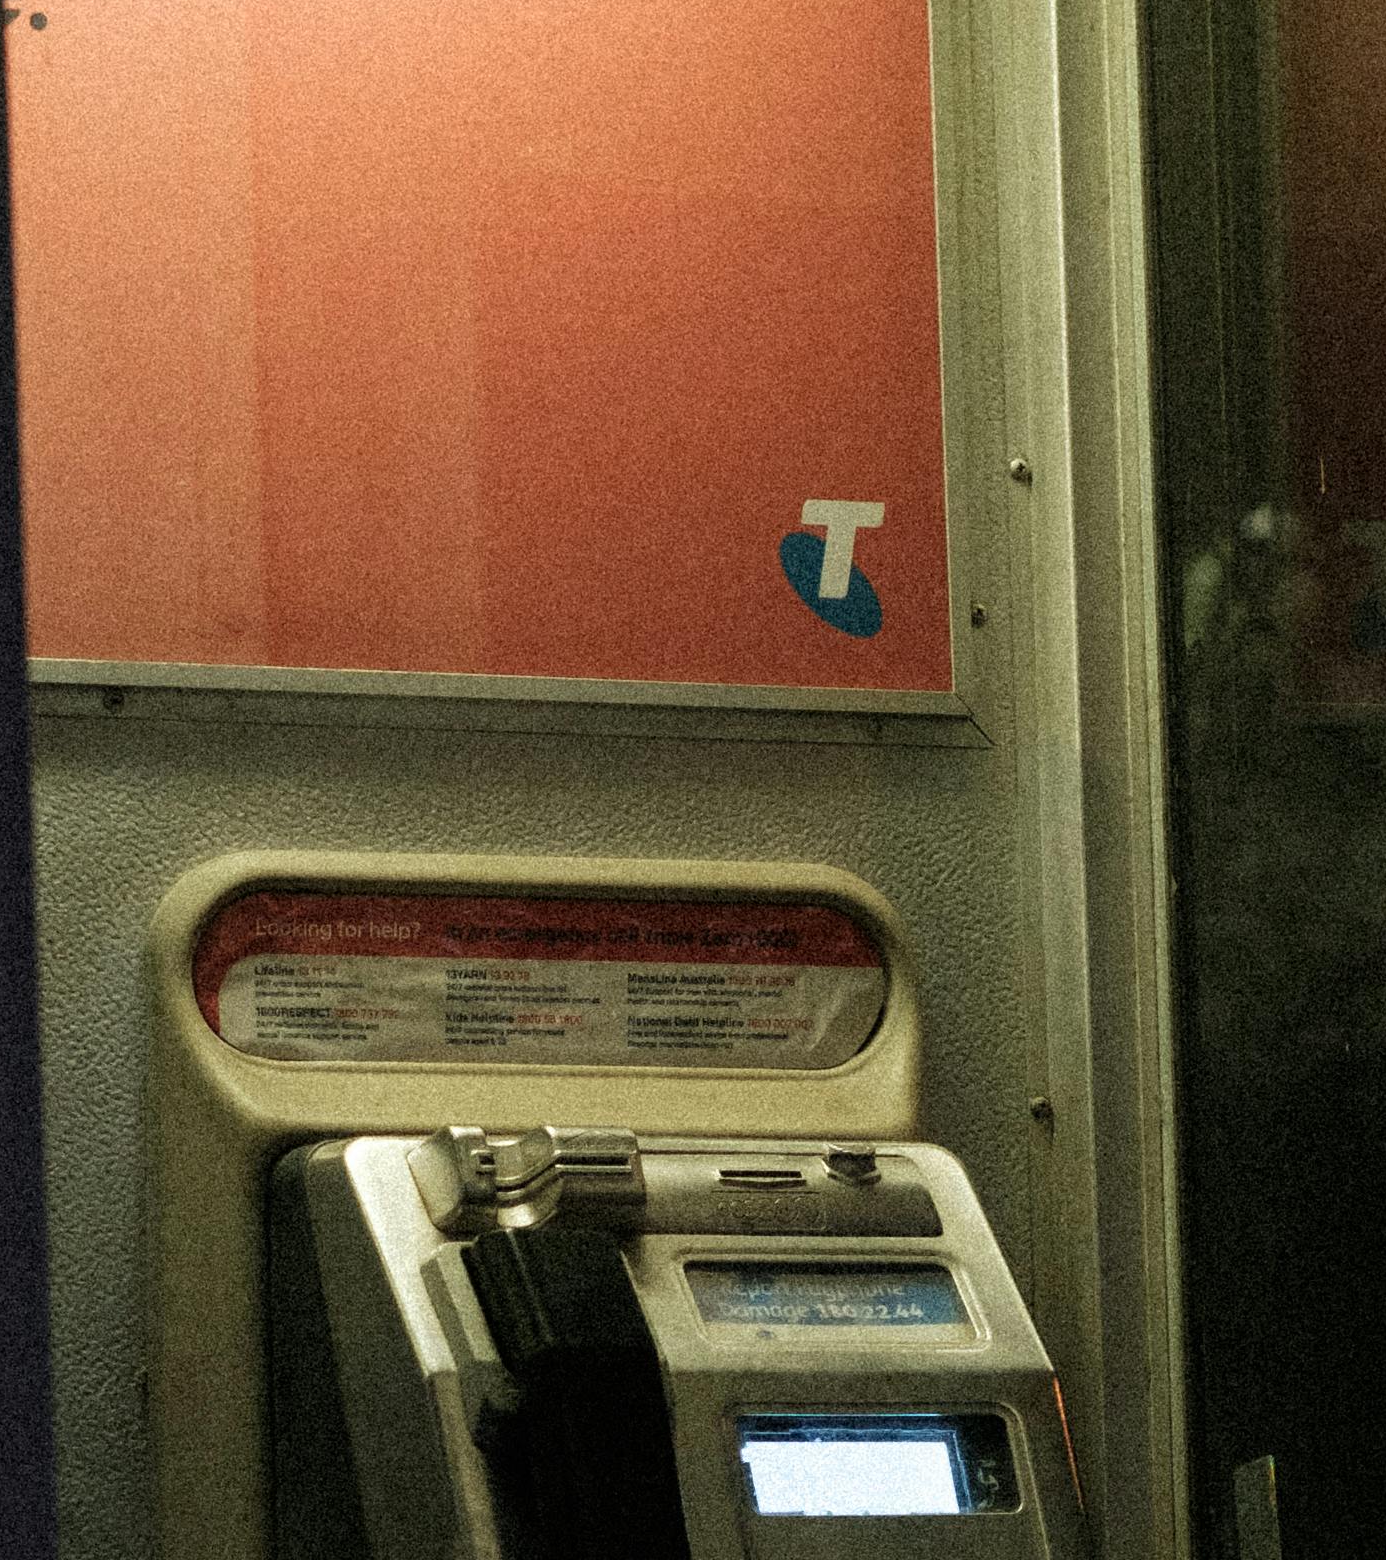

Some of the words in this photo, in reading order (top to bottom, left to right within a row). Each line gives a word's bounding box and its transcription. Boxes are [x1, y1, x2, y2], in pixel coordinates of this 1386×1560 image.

[801, 499, 885, 599] T
[255, 919, 332, 940] Looking
[337, 921, 364, 938] for
[369, 921, 420, 941] help?
[720, 1301, 808, 1323] Damage
